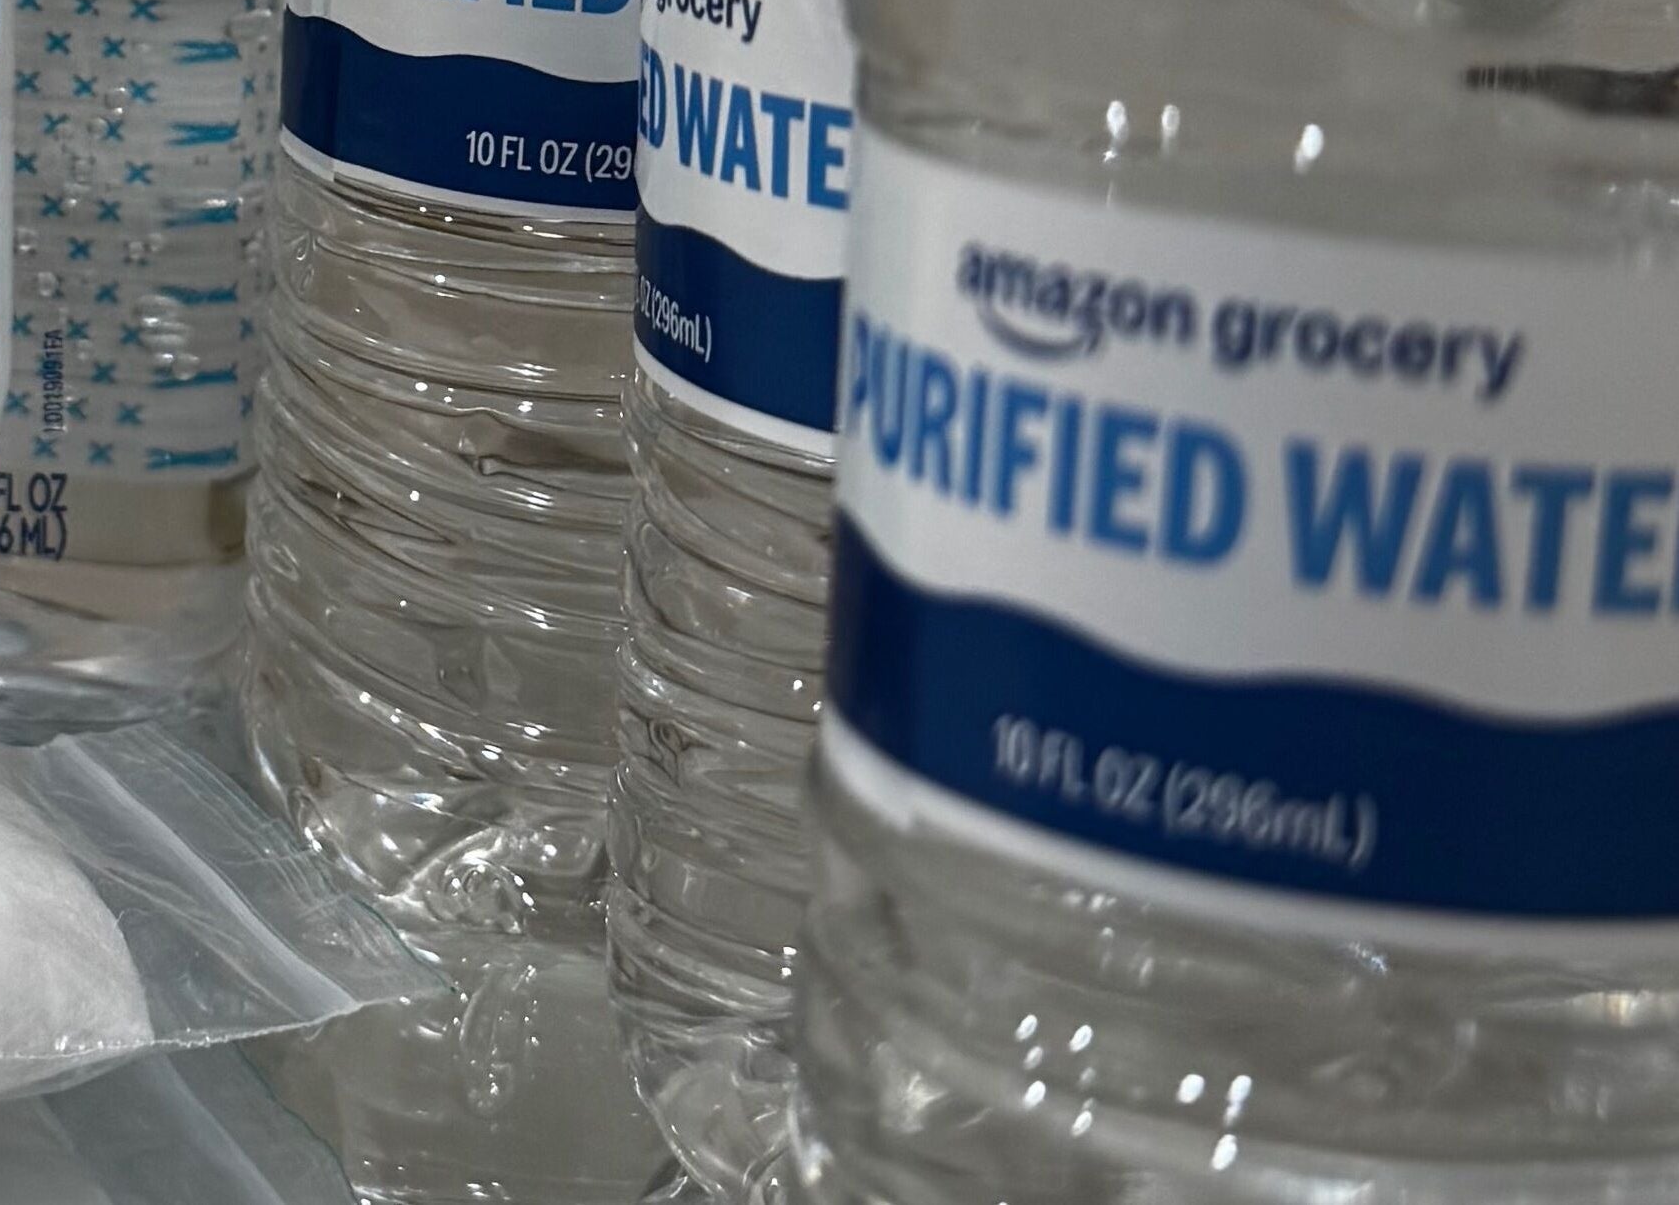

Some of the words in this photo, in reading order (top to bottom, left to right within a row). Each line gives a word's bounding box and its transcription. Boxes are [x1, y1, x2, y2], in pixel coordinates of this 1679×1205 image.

[466, 130, 495, 167] 10
[500, 135, 532, 171] FL
[539, 139, 578, 176] OZ
[674, 62, 854, 211] WATE
[651, 284, 712, 364] (296mL)
[955, 241, 1201, 345] amazon
[1213, 295, 1523, 405] grocery
[28, 473, 68, 513] OZ
[851, 307, 1248, 571] PURIFIED
[1283, 433, 1679, 618] WATE
[21, 512, 67, 561] ML)
[993, 712, 1038, 781] 10
[1038, 727, 1087, 804] FL
[1091, 744, 1162, 825] OZ
[1163, 758, 1379, 873] (296mL)
